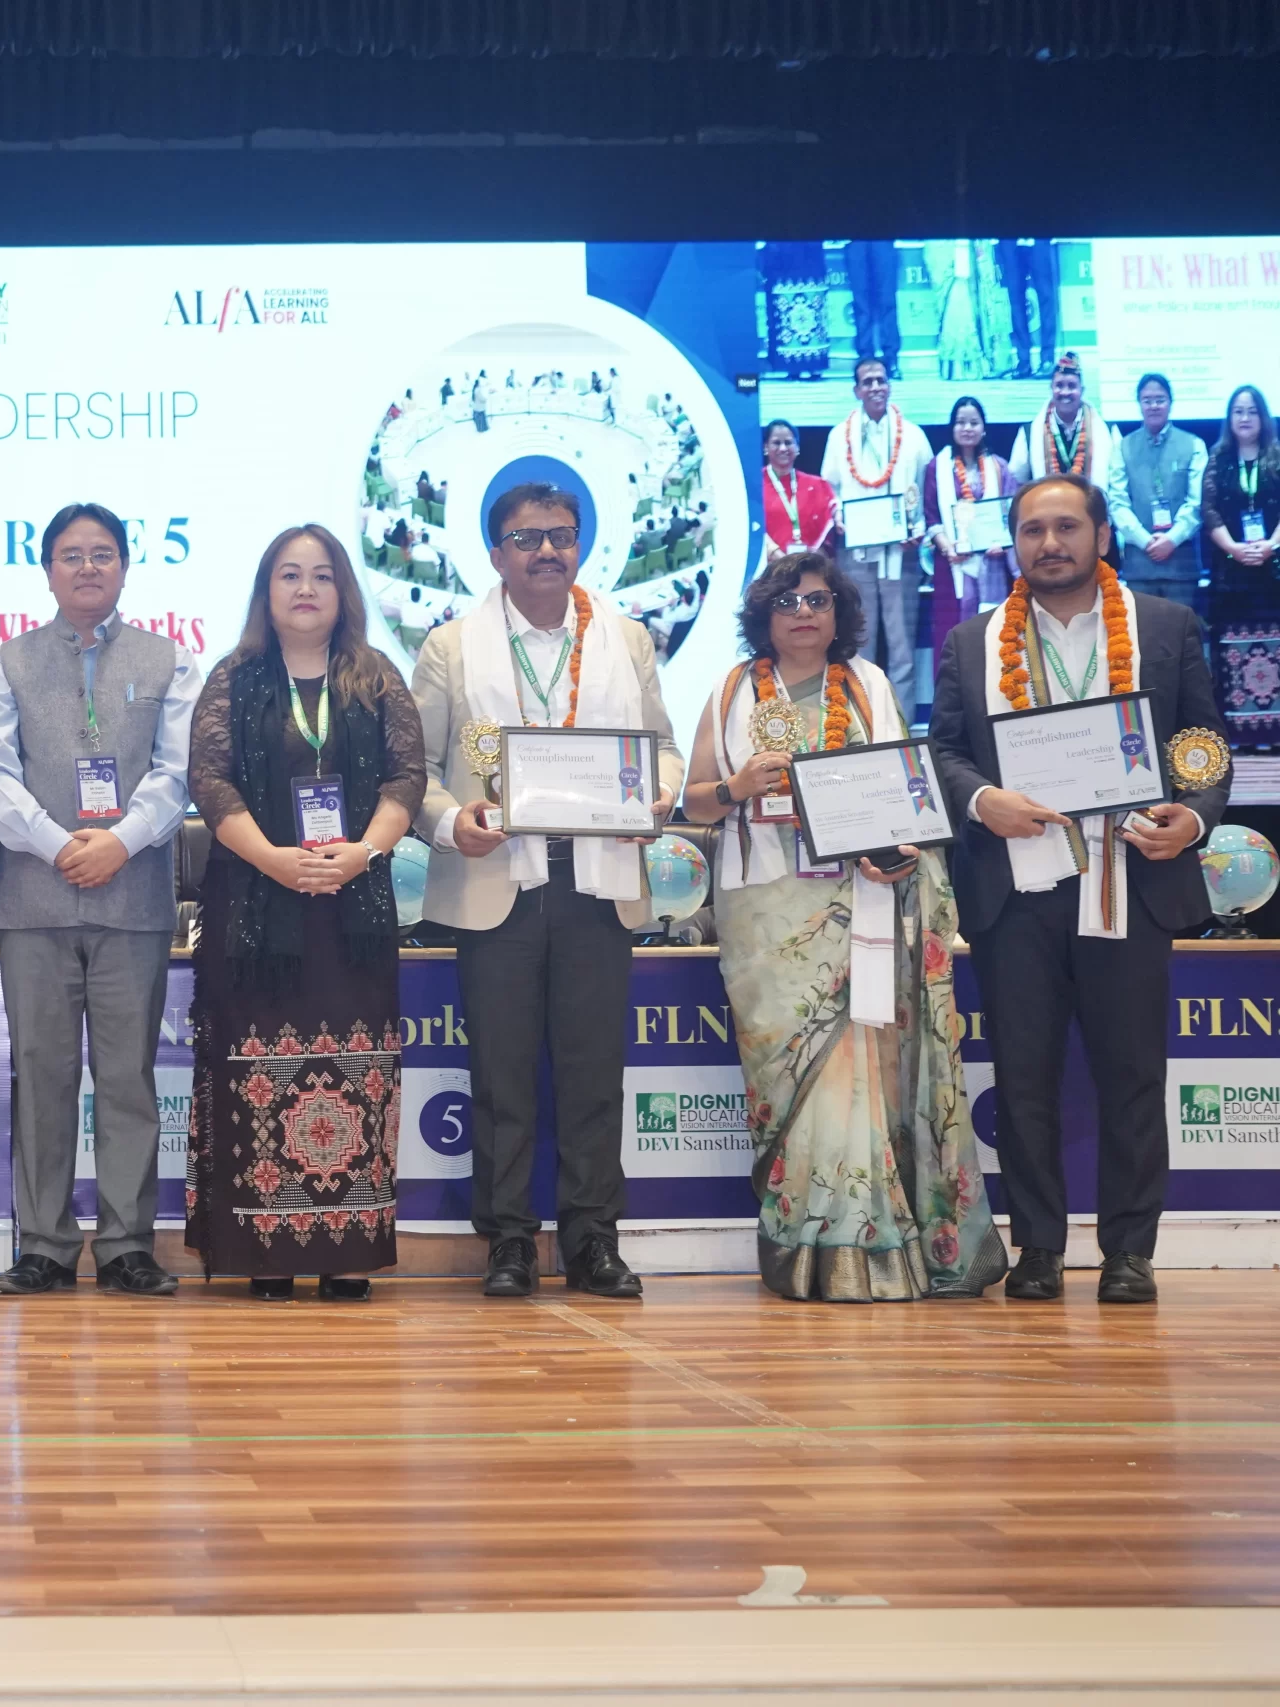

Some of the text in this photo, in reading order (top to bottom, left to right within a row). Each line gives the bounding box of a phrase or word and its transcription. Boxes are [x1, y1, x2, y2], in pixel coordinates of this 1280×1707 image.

[1183, 252, 1250, 288] What
[264, 288, 329, 296] ACCELERATING
[263, 297, 329, 309] LEARNING
[264, 311, 328, 324] FOR ALL
[164, 517, 190, 564] 5
[514, 641, 535, 683] DEVI SANSTHAN
[1046, 644, 1069, 686] DEVI SANSTHAN
[1008, 728, 1092, 748] Accomplishment
[1122, 738, 1142, 746] Circle
[518, 754, 595, 764] Accomplishment
[1066, 745, 1115, 759] Leadership
[105, 772, 110, 780] 5
[569, 772, 614, 781] Leadership
[807, 770, 882, 788] Accomplishment
[861, 788, 904, 800] Leadership
[91, 805, 109, 814] VIP
[315, 834, 334, 844] VIP
[1176, 998, 1280, 1036] FLN
[399, 1004, 469, 1047] ork
[633, 1005, 730, 1045] FLN
[1223, 1086, 1280, 1102] DIGNI
[680, 1094, 746, 1110] DIGNIT
[1224, 1102, 1280, 1115] EDUCAT
[680, 1109, 749, 1122] EDUCATIO
[440, 1105, 464, 1144] 5
[706, 1121, 748, 1129] INTERNATIO
[1181, 1126, 1280, 1143] DEVI Sansth
[637, 1137, 679, 1152] DEVI
